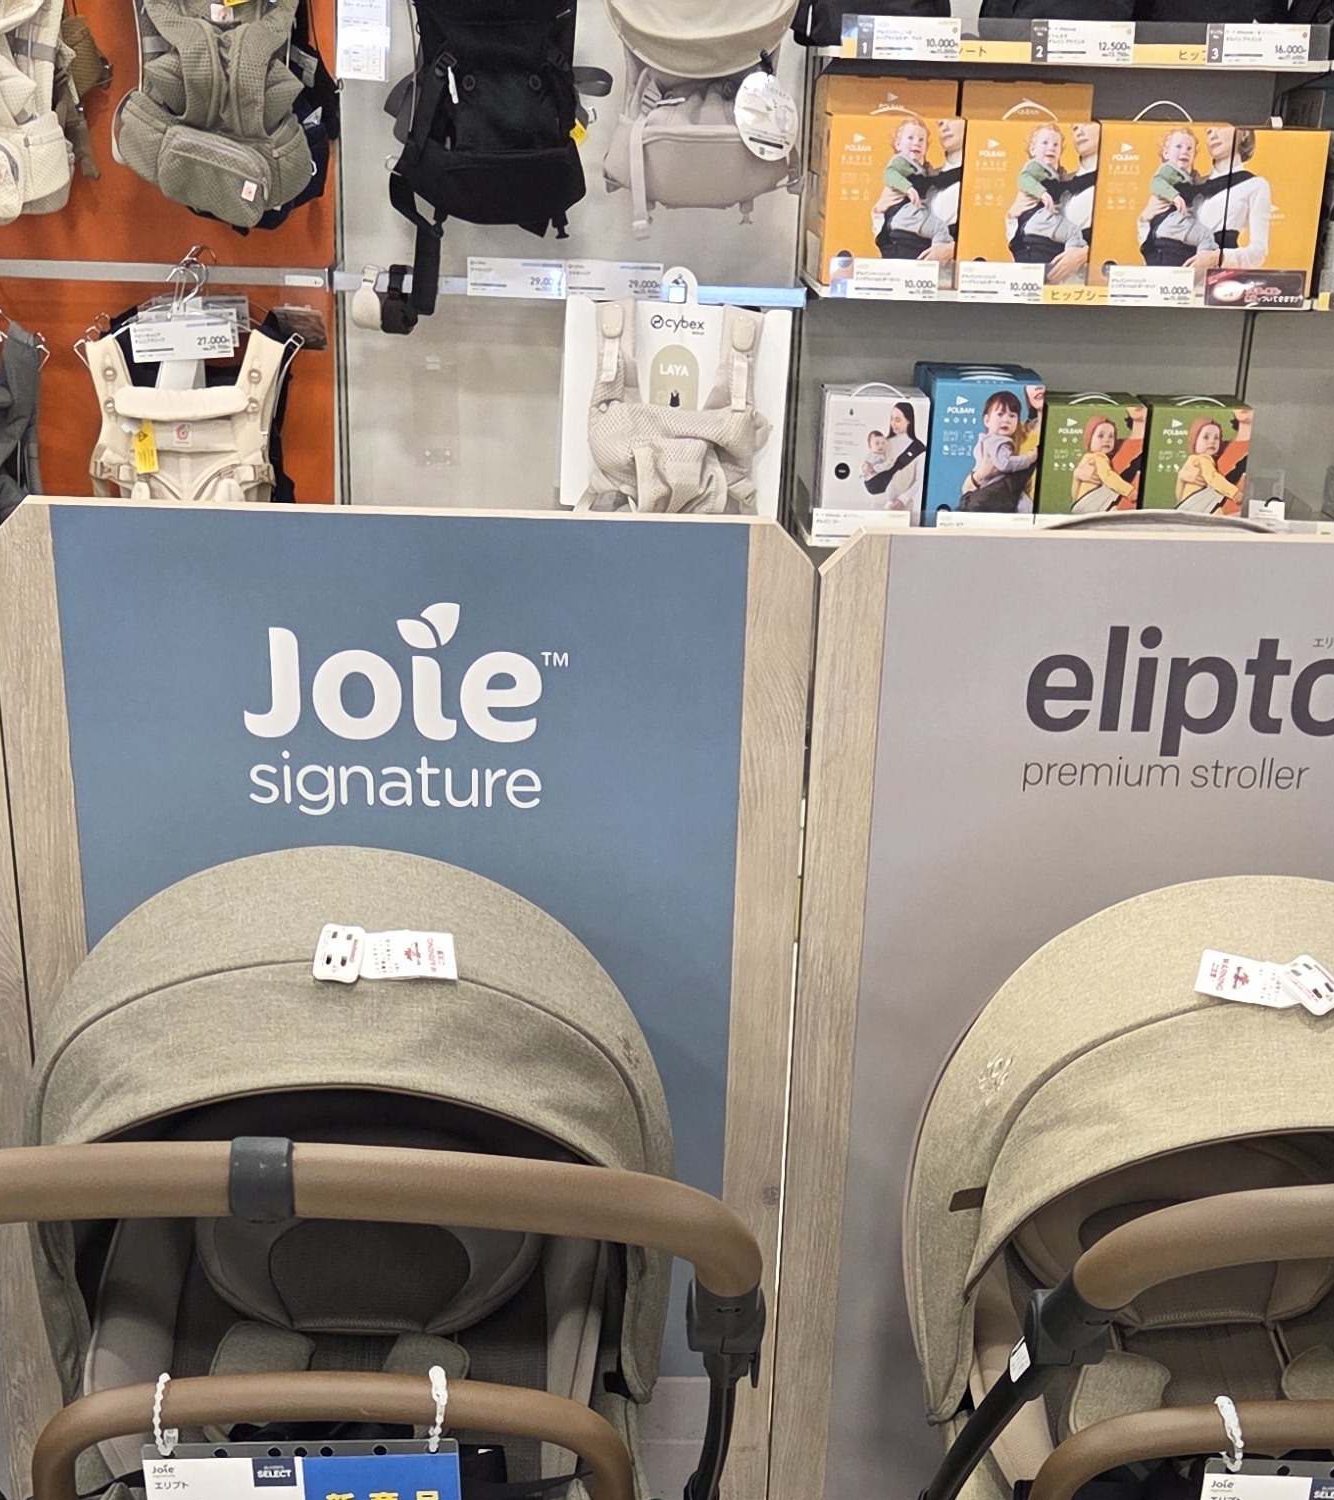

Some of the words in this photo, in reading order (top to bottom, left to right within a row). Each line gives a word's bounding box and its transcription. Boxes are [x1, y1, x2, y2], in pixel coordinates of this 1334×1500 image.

[665, 313, 705, 332] cybex
[659, 363, 690, 377] LAYA
[946, 406, 975, 415] POLBAN
[1058, 427, 1084, 436] POLBAN
[1163, 428, 1189, 437] POLBAN
[243, 602, 543, 743] Joie
[1022, 756, 1181, 792] premium
[1190, 757, 1310, 790] stroller
[248, 750, 542, 816] signature
[152, 1464, 175, 1474] Joie
[256, 1469, 292, 1478] SELECT
[154, 1481, 189, 1490] エリプト
[1210, 1479, 1235, 1489] Joie
